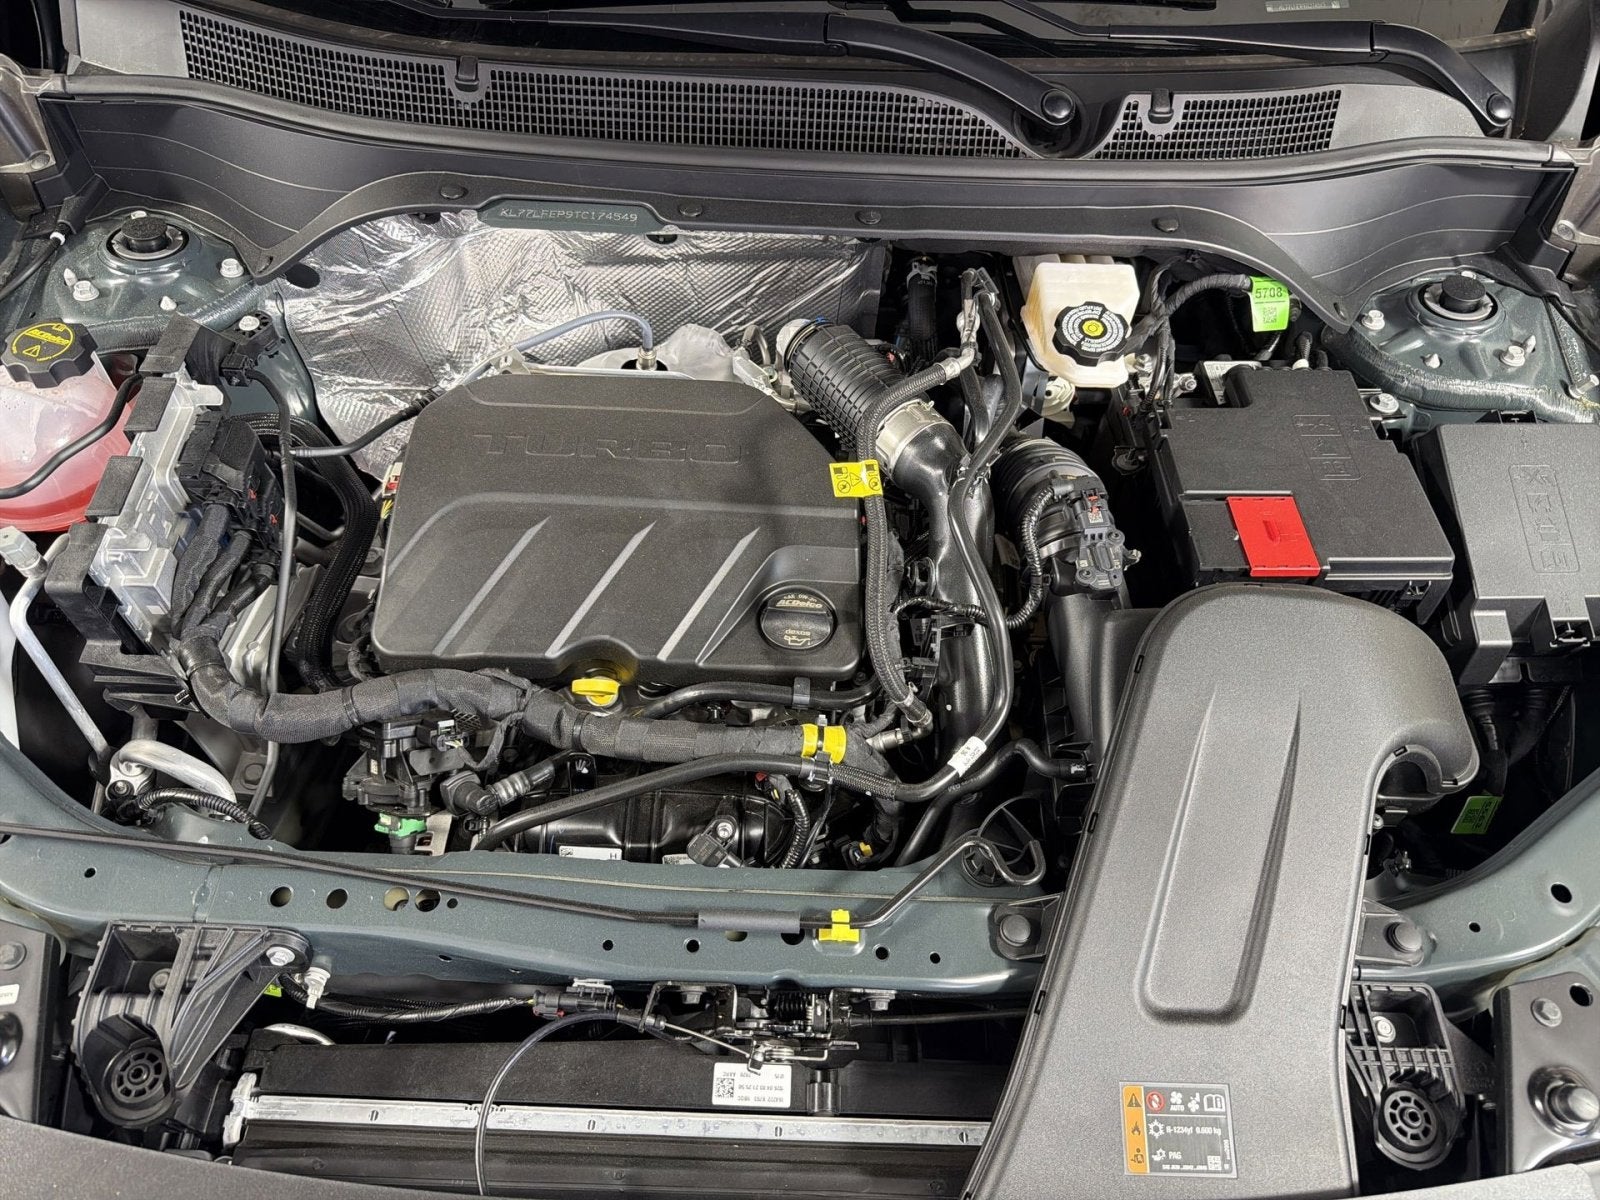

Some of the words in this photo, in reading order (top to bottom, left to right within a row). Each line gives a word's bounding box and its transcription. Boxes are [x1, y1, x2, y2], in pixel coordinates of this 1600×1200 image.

[1255, 286, 1283, 299] 5708
[472, 433, 740, 465] TURBO
[776, 599, 823, 609] ACDelco
[1213, 1126, 1222, 1136] kg
[1168, 1151, 1182, 1160] PAG
